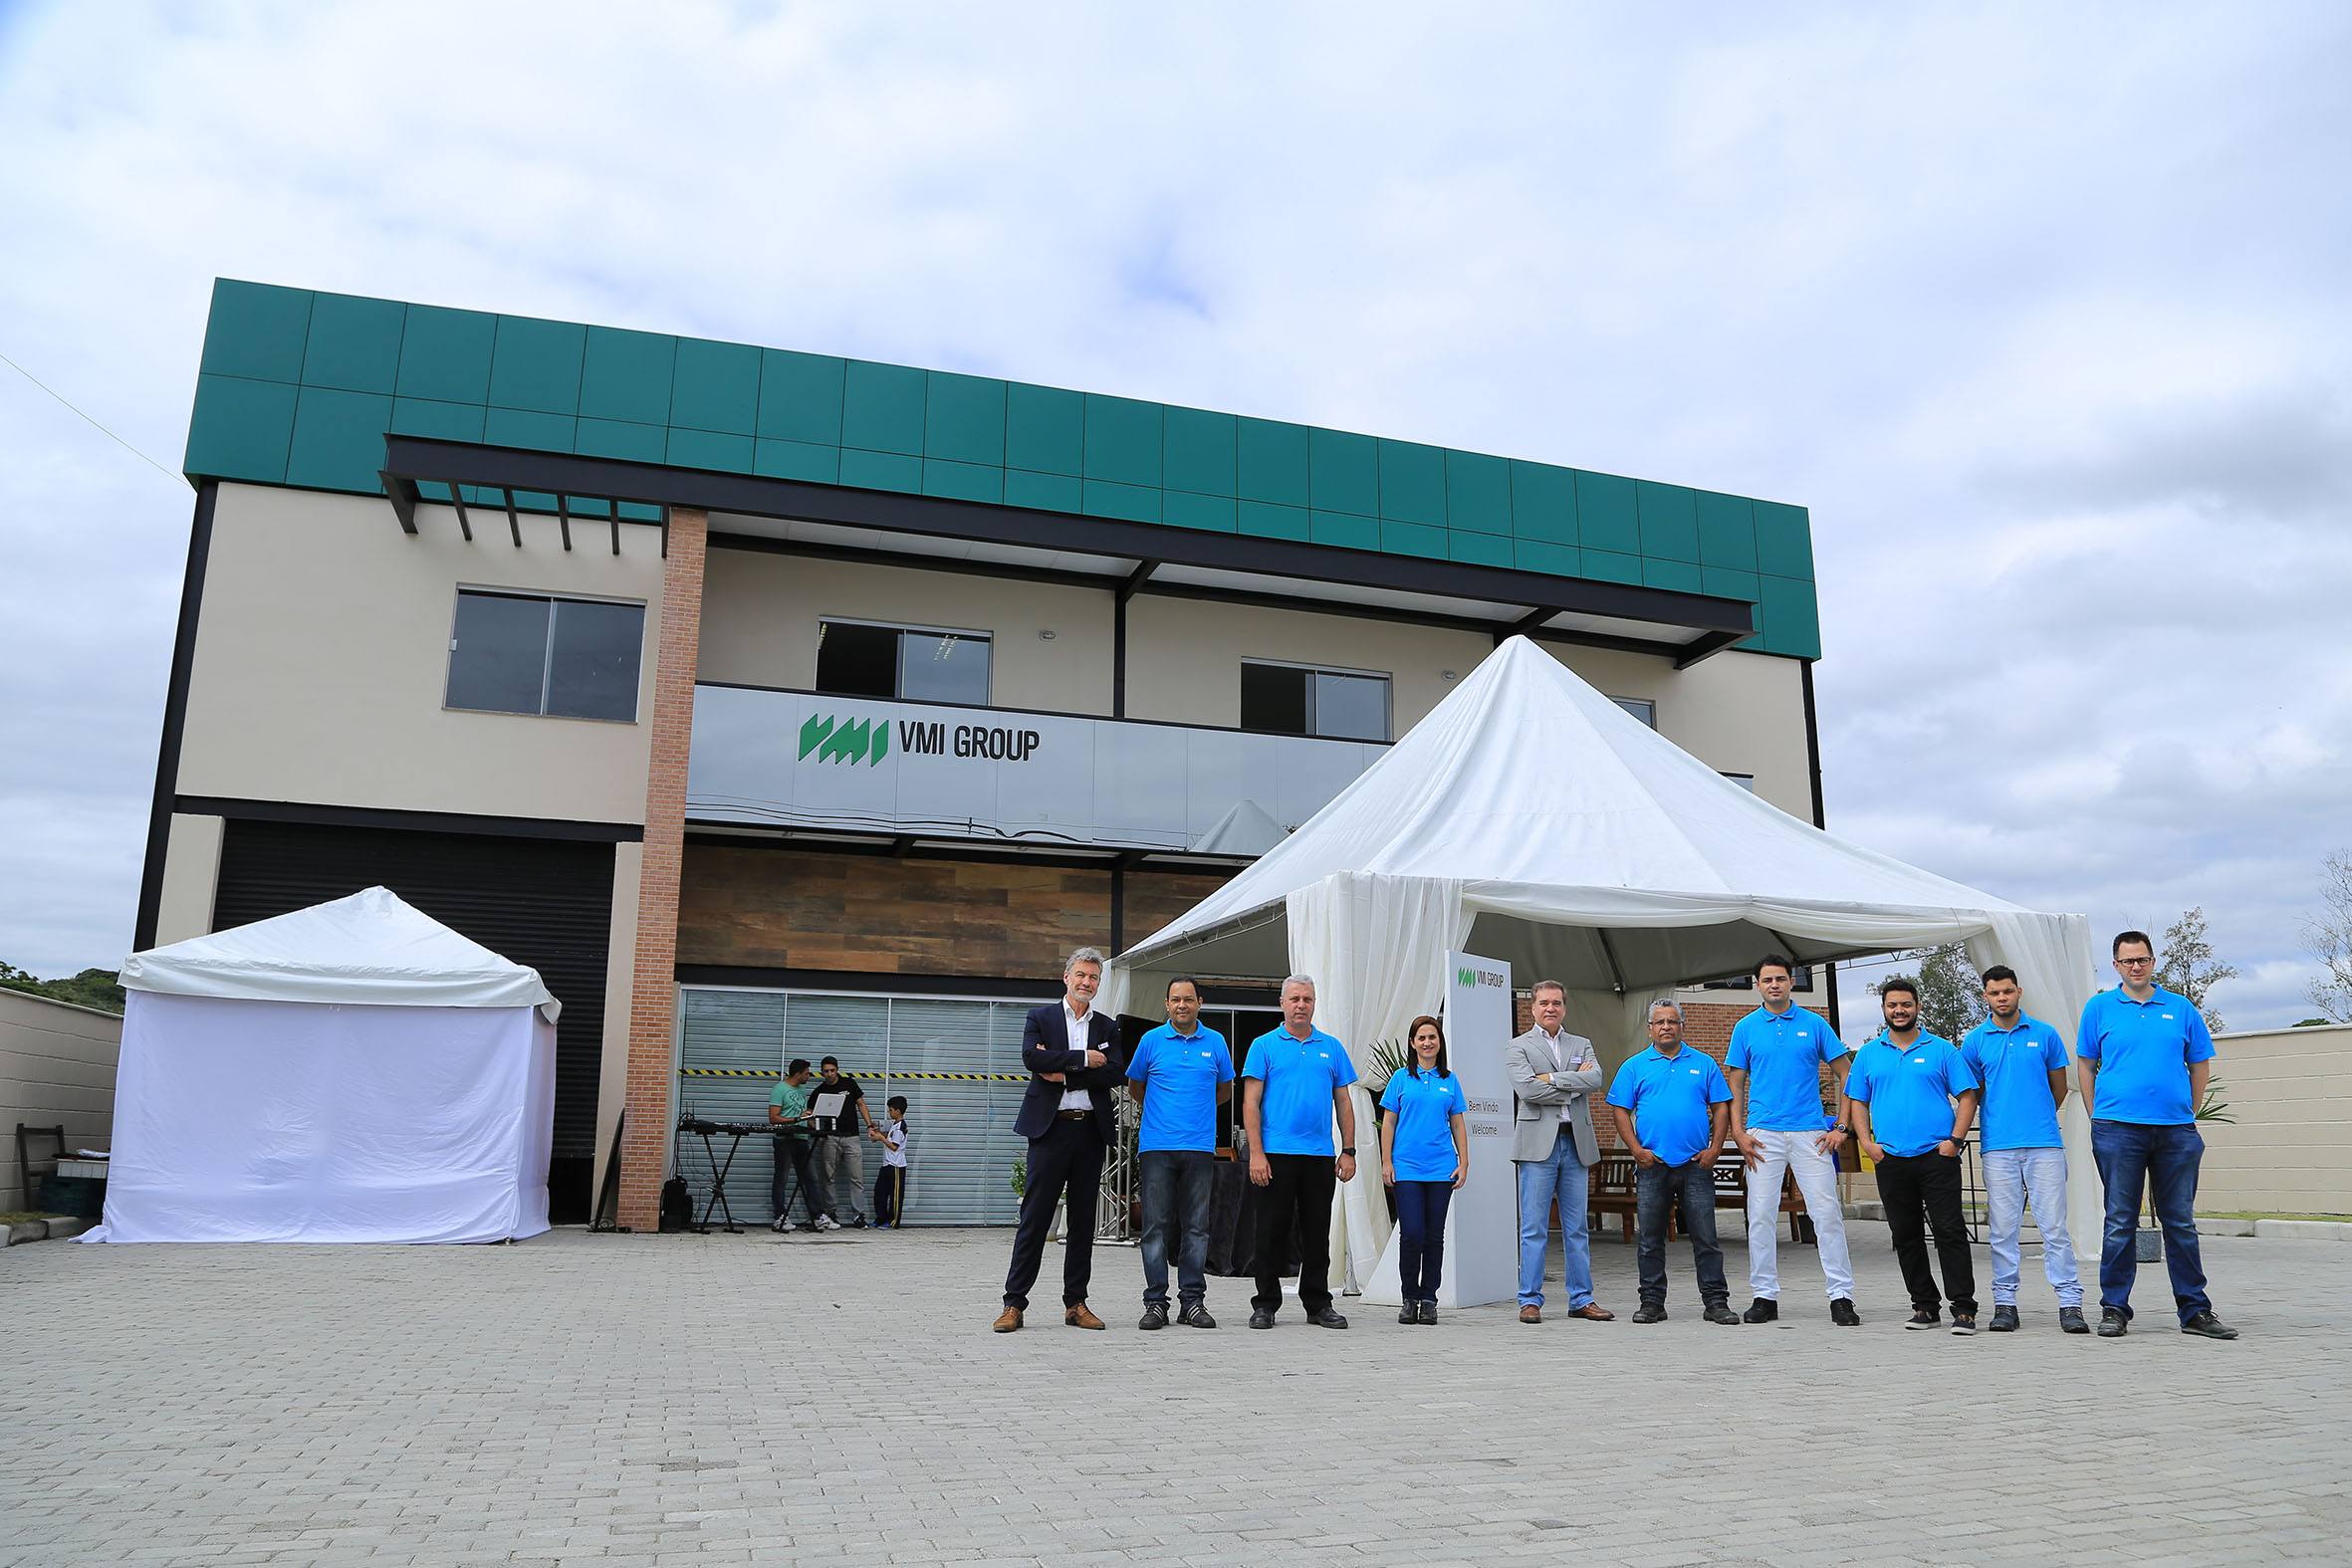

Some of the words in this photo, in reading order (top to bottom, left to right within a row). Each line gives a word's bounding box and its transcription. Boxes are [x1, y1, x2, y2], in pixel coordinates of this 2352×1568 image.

[898, 720, 946, 756] VMI
[953, 725, 1041, 762] GROUP
[1476, 970, 1487, 985] VMI
[1487, 972, 1506, 988] GROUP
[1468, 1100, 1482, 1112] Bem
[1482, 1100, 1500, 1113] Vindo
[1471, 1123, 1498, 1136] Welcome
